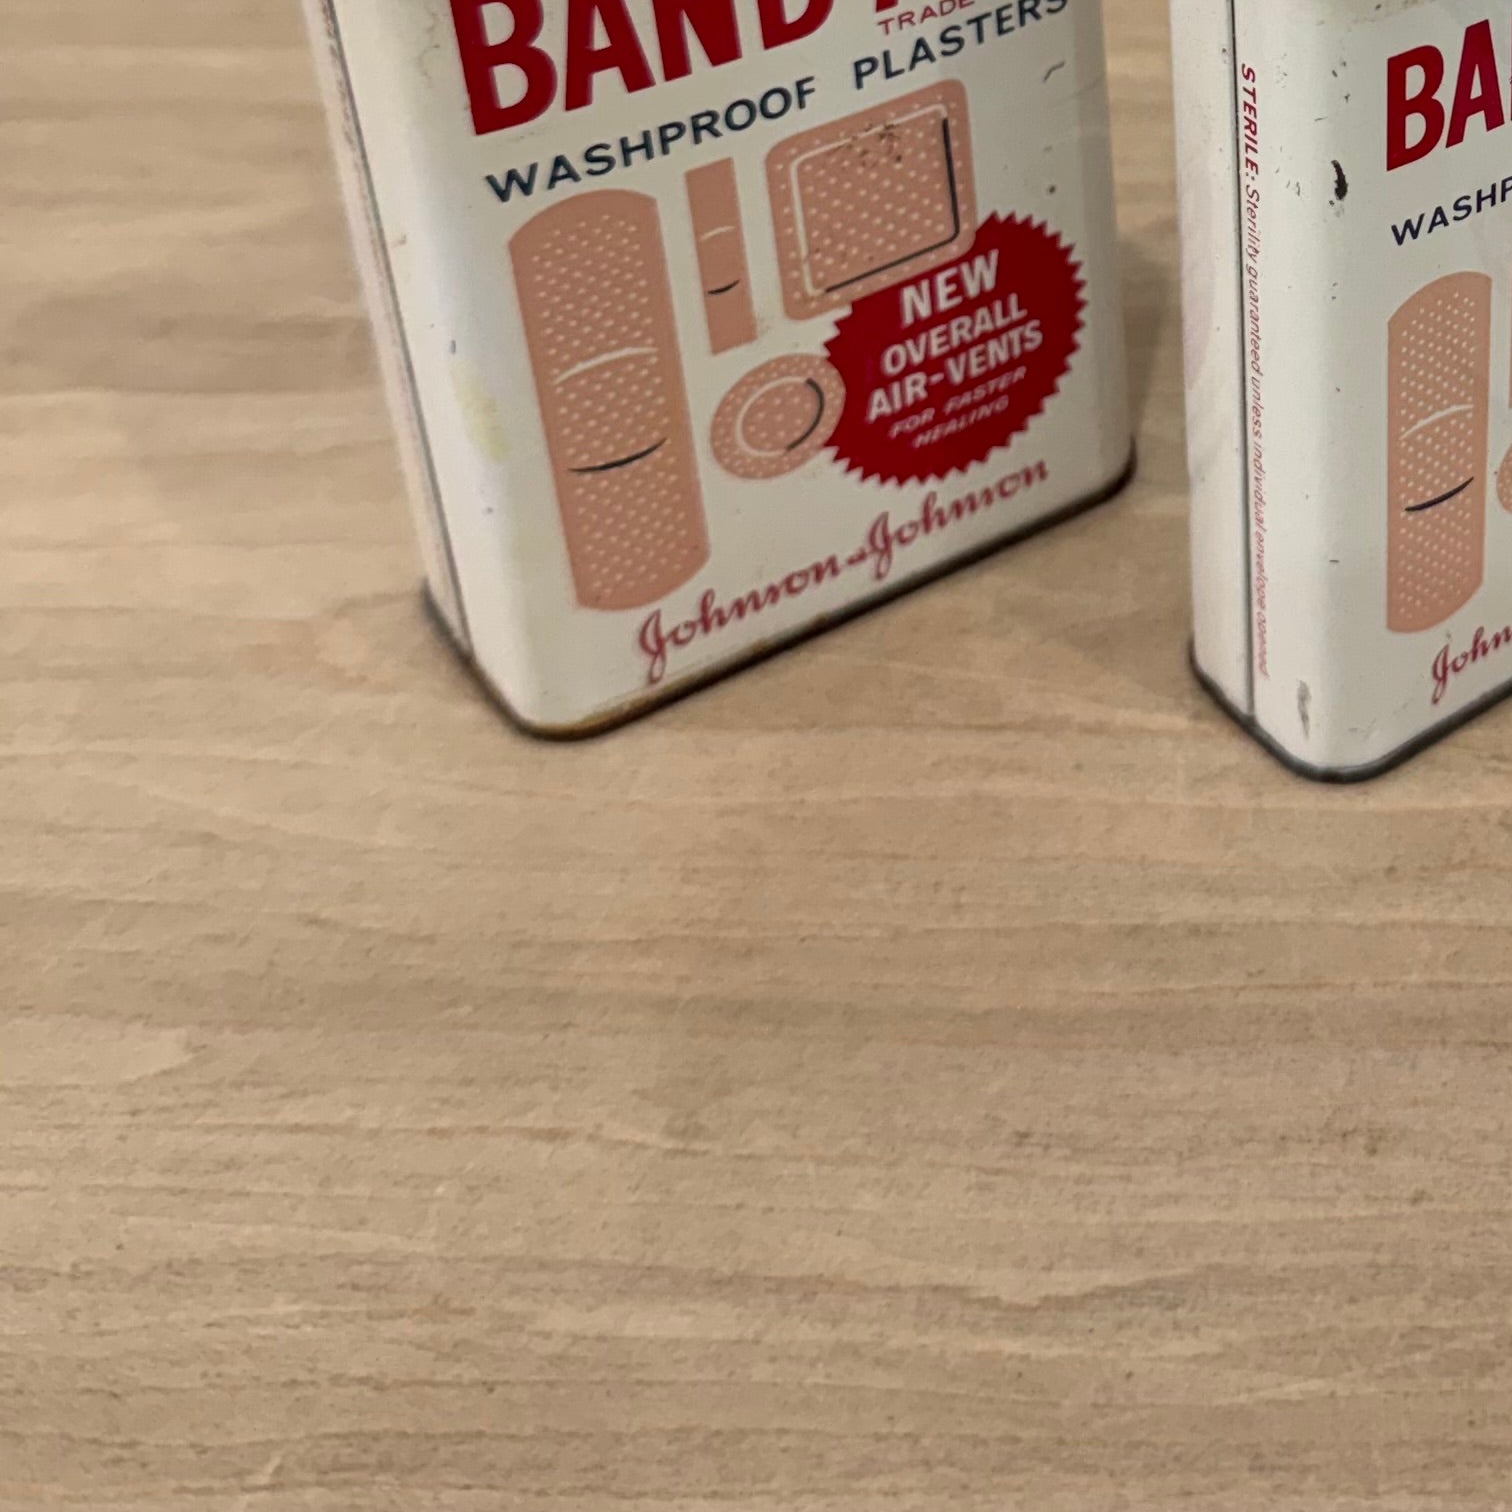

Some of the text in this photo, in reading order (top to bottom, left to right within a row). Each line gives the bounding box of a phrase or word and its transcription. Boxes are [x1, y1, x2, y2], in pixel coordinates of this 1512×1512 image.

[485, 76, 817, 203] WASHPROOF
[1245, 184, 1261, 263] Sterility
[901, 249, 1000, 328] NEW
[1245, 263, 1264, 376] guaranteed
[865, 319, 1043, 424] AIR-VENTS
[881, 293, 1028, 376] OVERALL
[889, 365, 1028, 439] FOR FASTER
[911, 394, 1009, 449] HEALING
[1251, 376, 1264, 439] unless
[1252, 441, 1267, 530] individual
[637, 554, 840, 685] Johnson
[866, 459, 1048, 580] Johnson
[1254, 530, 1269, 607] envelope
